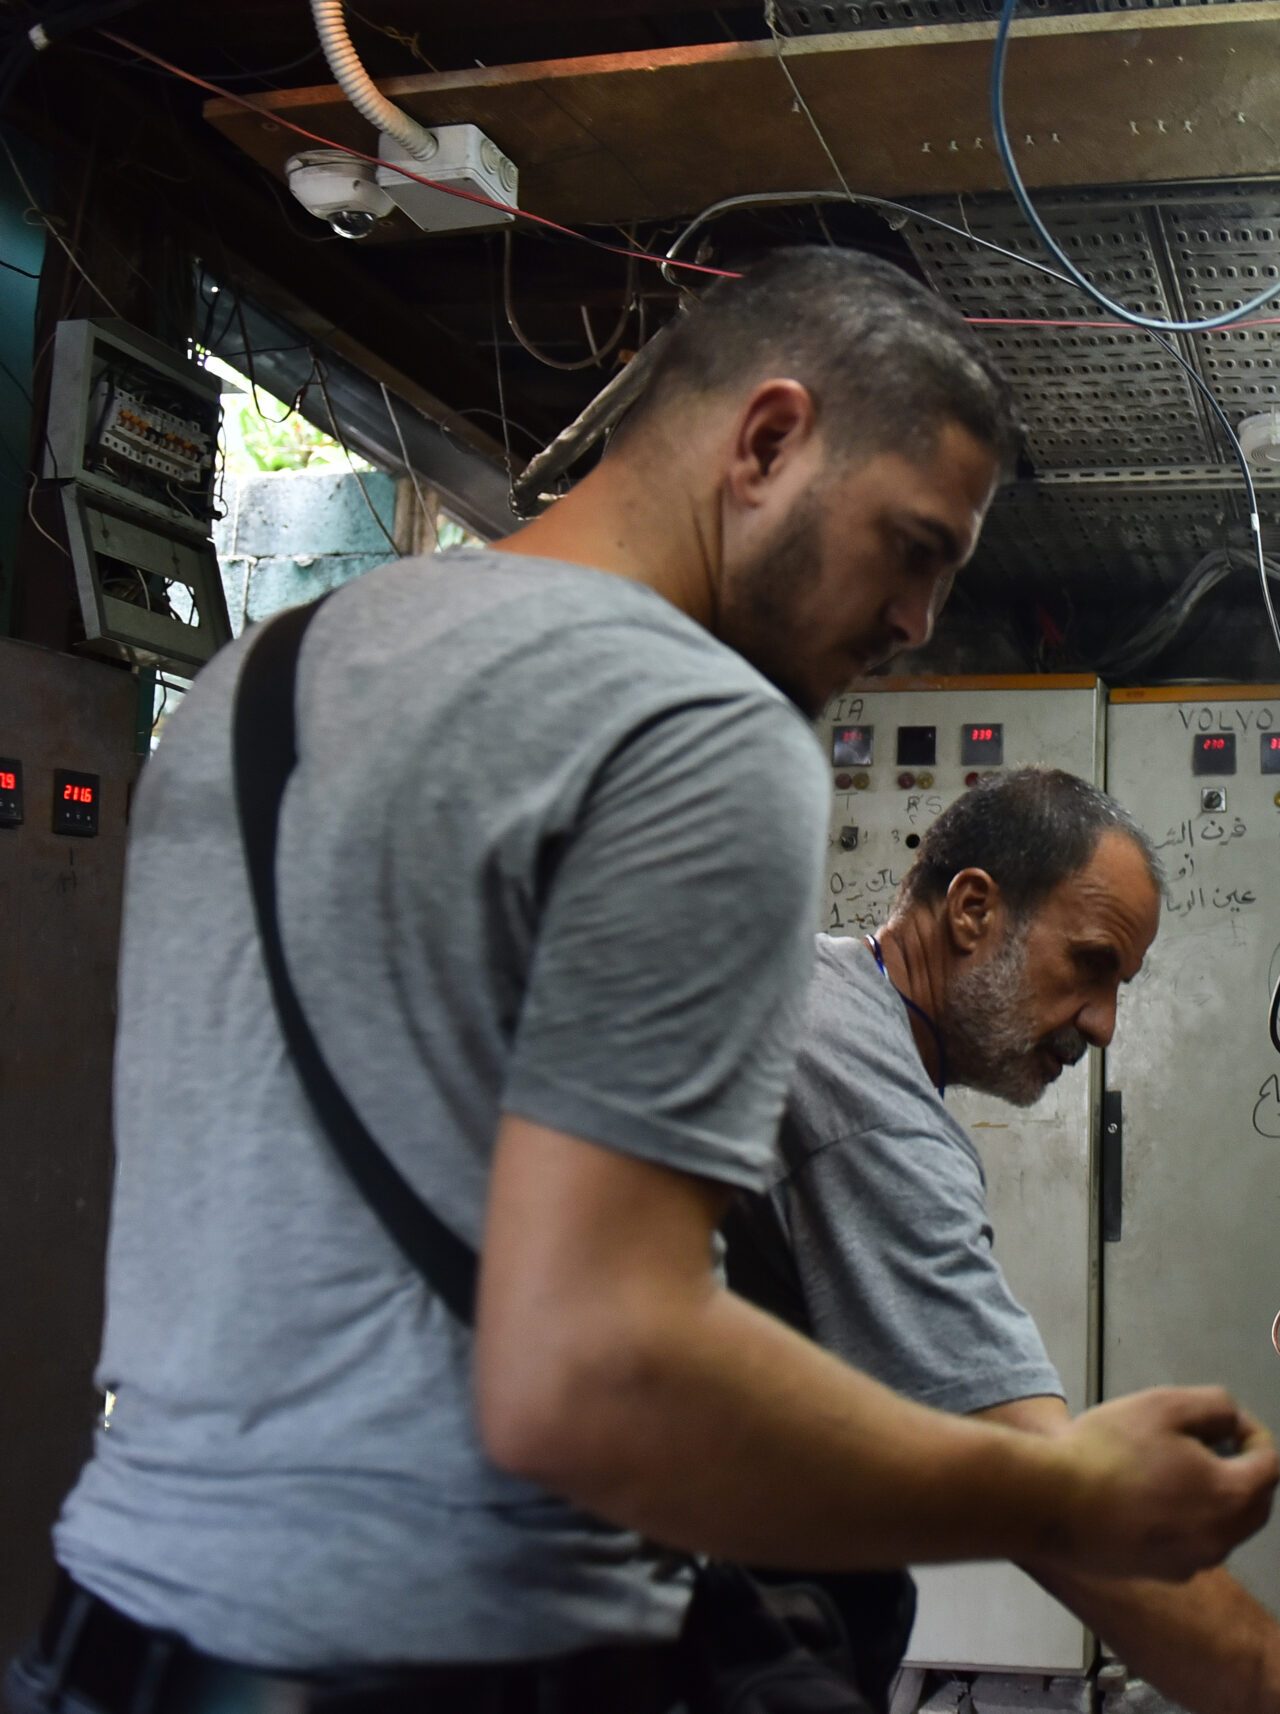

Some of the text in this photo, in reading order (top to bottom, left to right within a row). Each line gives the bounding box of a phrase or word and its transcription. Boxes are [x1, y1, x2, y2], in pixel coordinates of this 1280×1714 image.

[827, 699, 864, 721] IA
[1178, 707, 1274, 732] VOLVO
[1200, 817, 1247, 846] فرن
[1166, 888, 1257, 918] عين الرما
